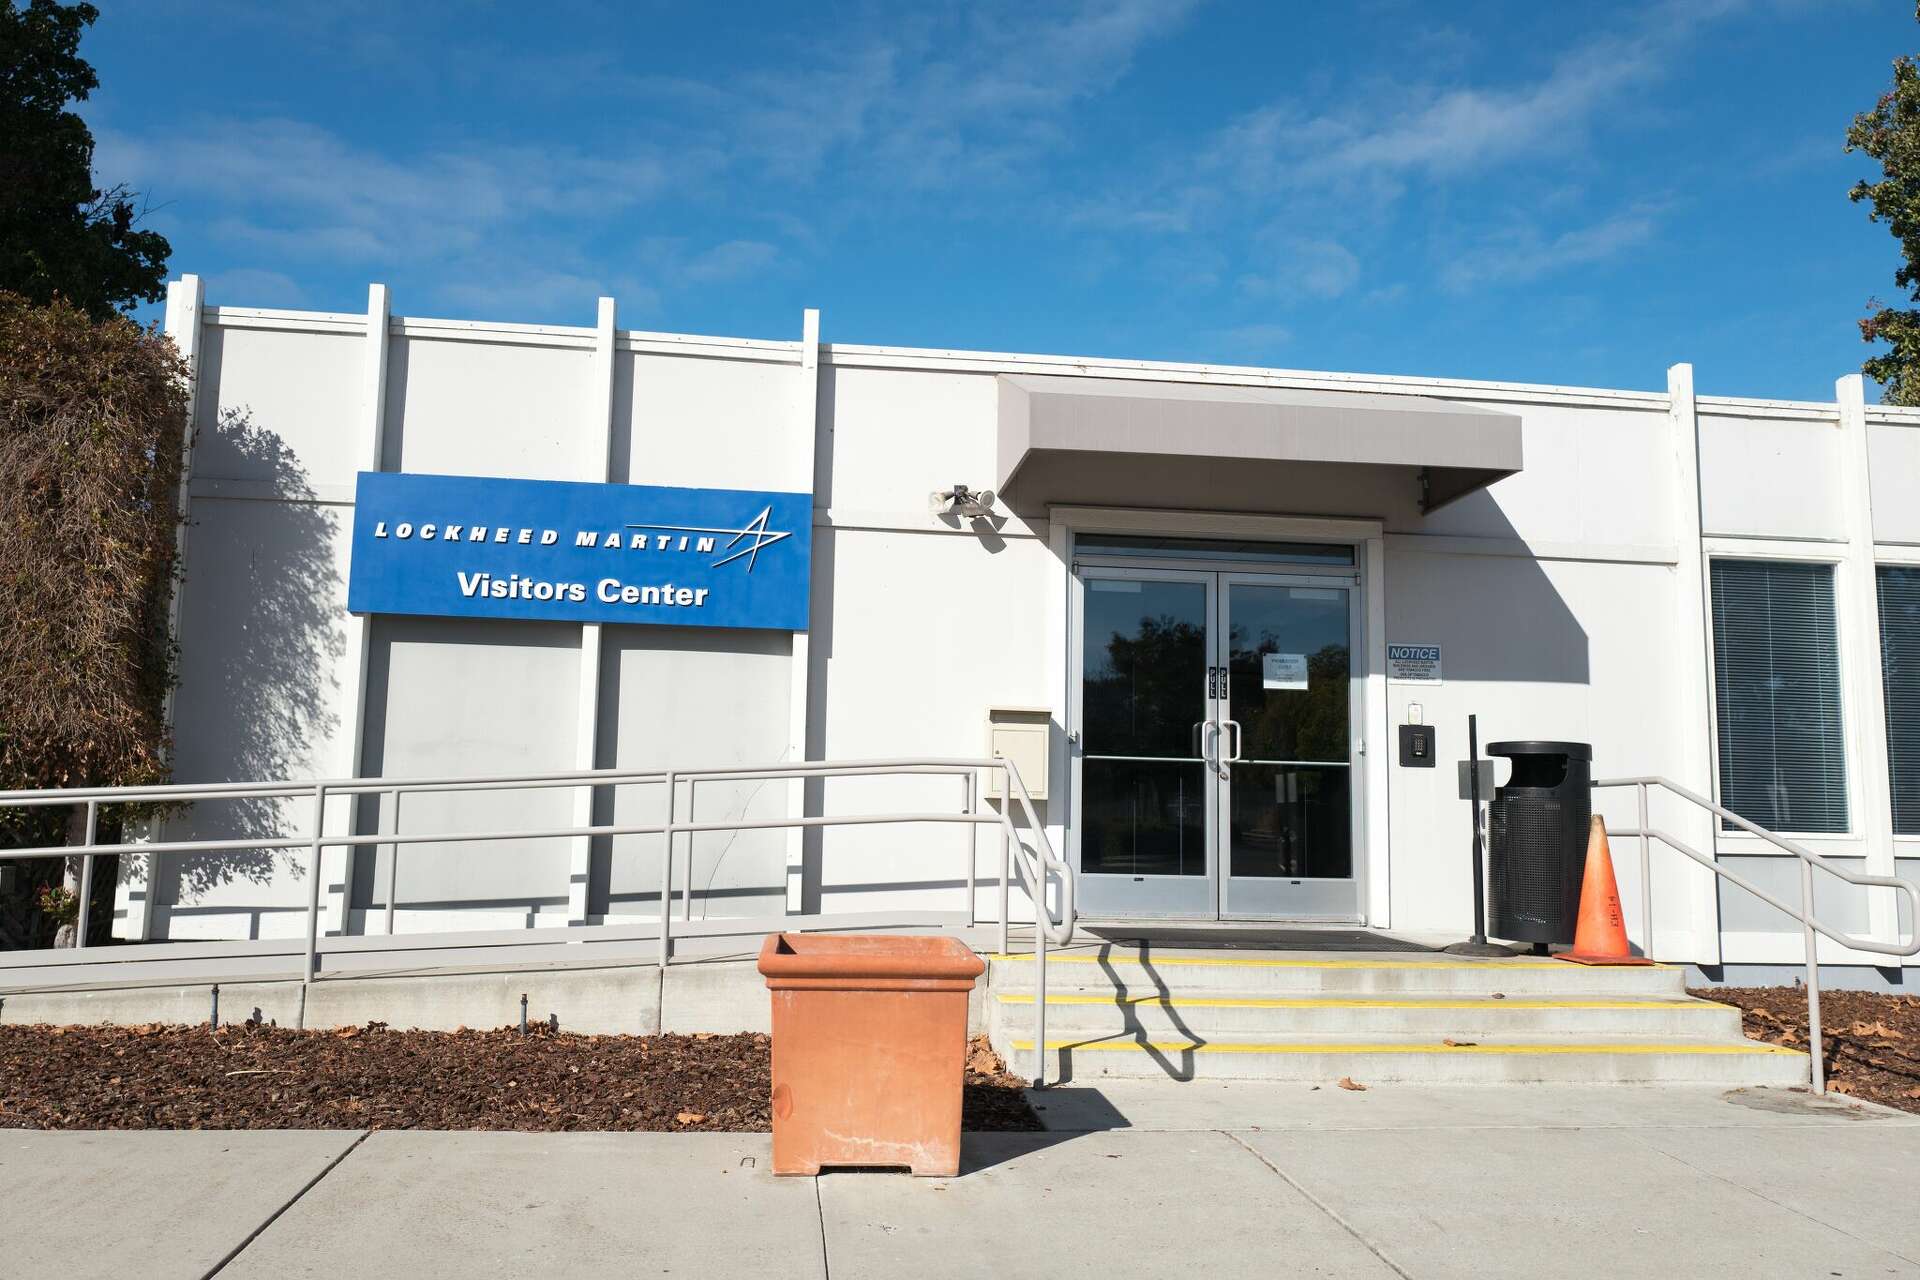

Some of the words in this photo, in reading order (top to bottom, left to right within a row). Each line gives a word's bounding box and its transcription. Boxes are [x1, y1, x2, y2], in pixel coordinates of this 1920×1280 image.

[374, 521, 559, 545] LOCKHEED
[575, 531, 715, 553] MARTIN
[456, 571, 586, 602] Visitors
[596, 578, 709, 606] Center
[1390, 647, 1437, 660] NOTICE
